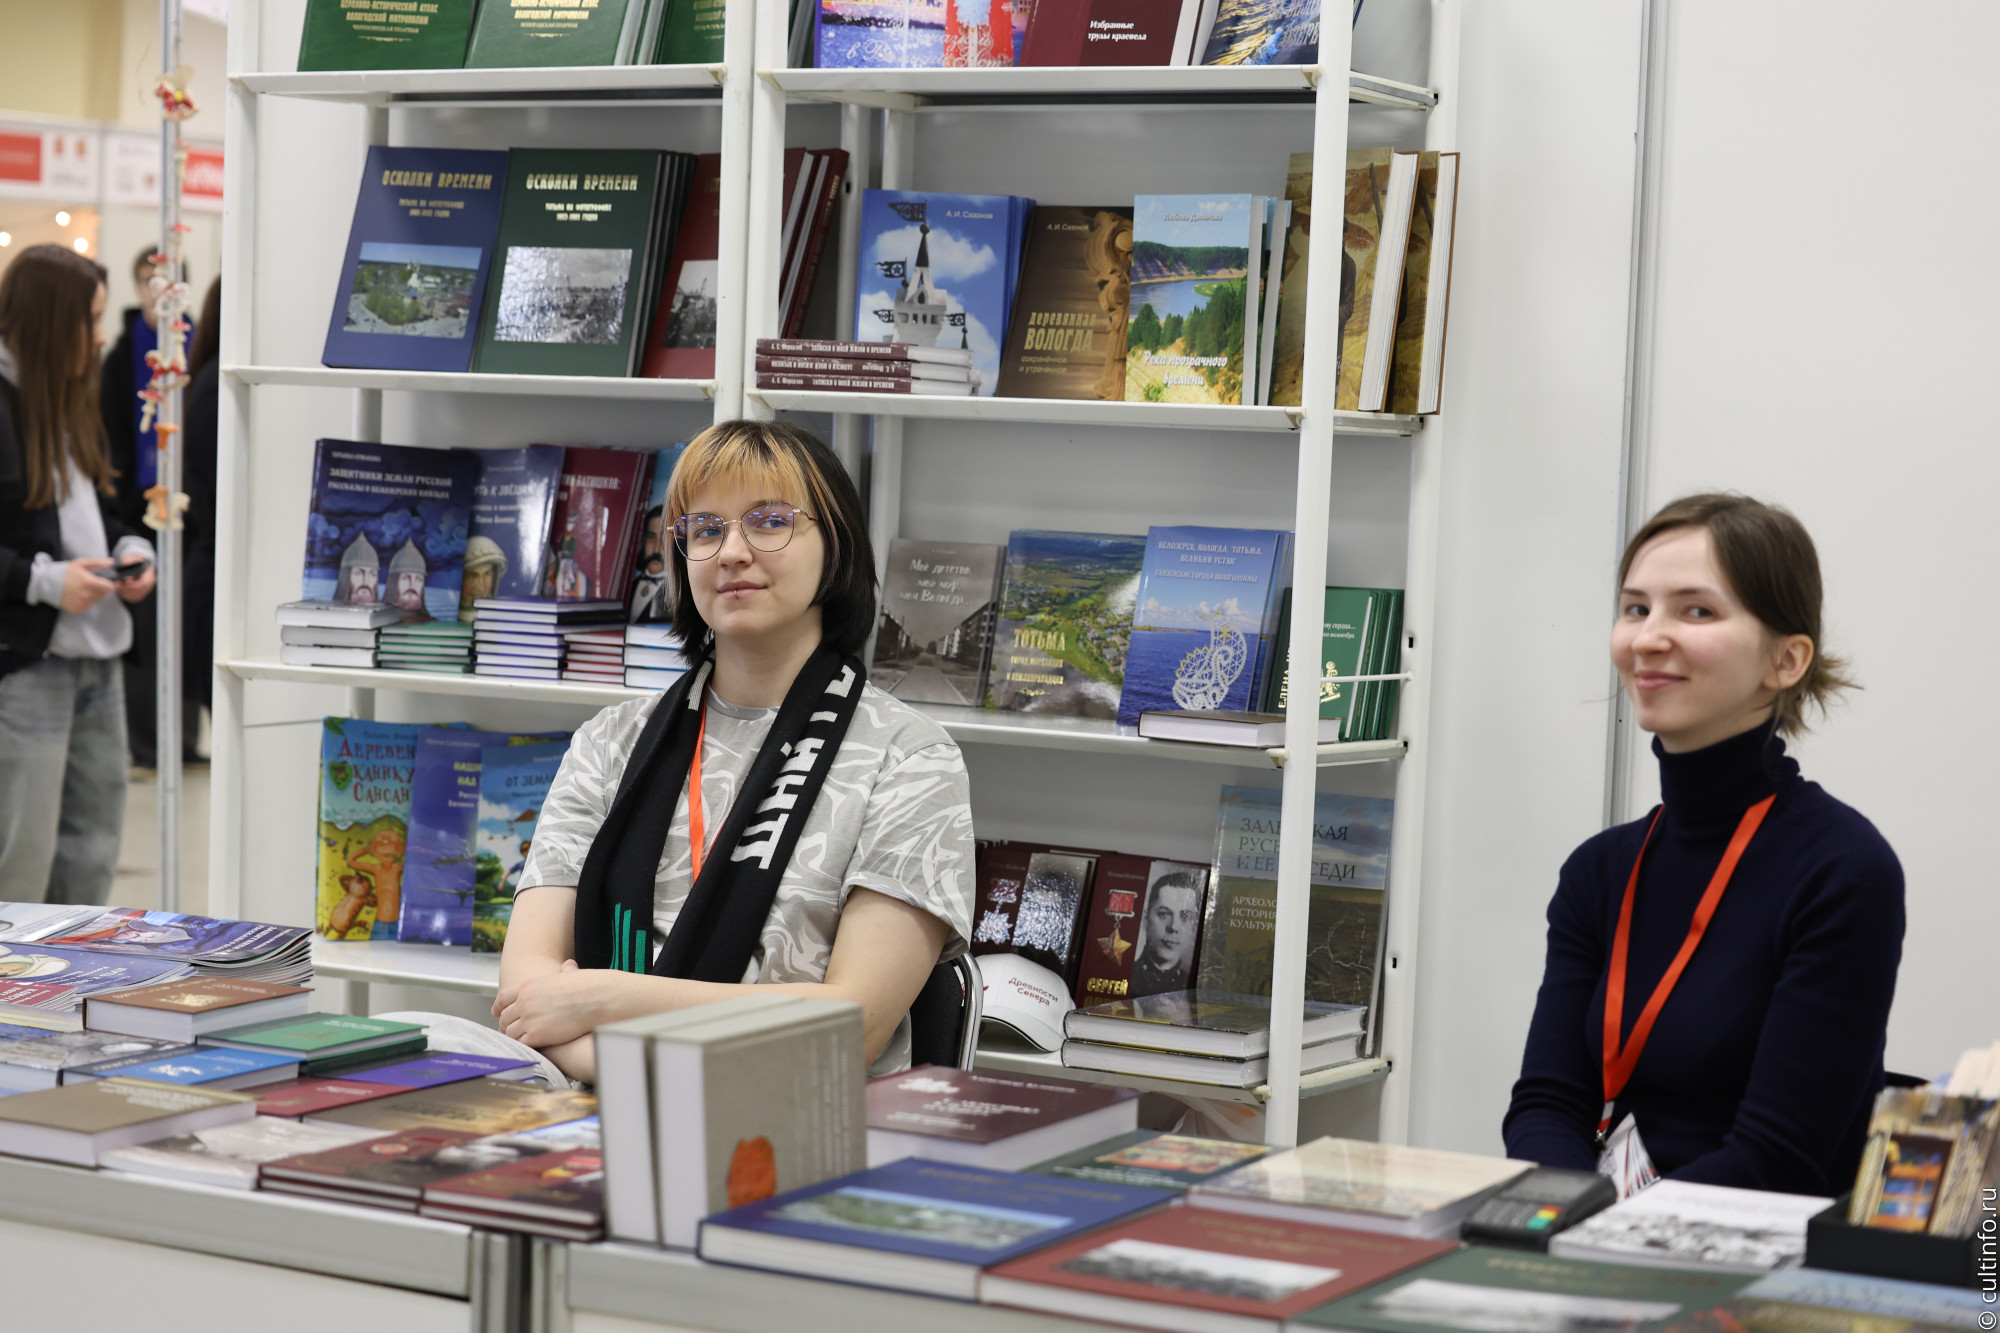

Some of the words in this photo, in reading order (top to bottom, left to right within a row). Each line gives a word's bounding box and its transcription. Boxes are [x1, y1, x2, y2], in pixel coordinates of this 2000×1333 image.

[1090, 20, 1134, 30] Избранные
[382, 170, 433, 187] ОСКОЛКИ
[438, 172, 492, 190] ВРЕМЕНИ
[526, 173, 578, 190] ОСКОЛКИ
[583, 174, 639, 191] ВРЕМЕНИ
[1028, 311, 1097, 327] деревянная
[1023, 327, 1094, 353] ВОЛОГДА
[1144, 350, 1167, 366] Река
[1169, 356, 1228, 368] прозрачного
[1163, 370, 1205, 388] времени
[1013, 628, 1066, 651] ТОТЬМА
[337, 738, 415, 761] ДЕРЕВЕН
[353, 764, 416, 784] КАНИКУ
[505, 776, 519, 788] ОТ
[353, 782, 411, 805] САНСАН
[1236, 854, 1249, 869] И
[1008, 976, 1059, 1003] Древности
[1087, 976, 1129, 996] СЕРГЕЙ
[1017, 987, 1051, 1007] Севера
